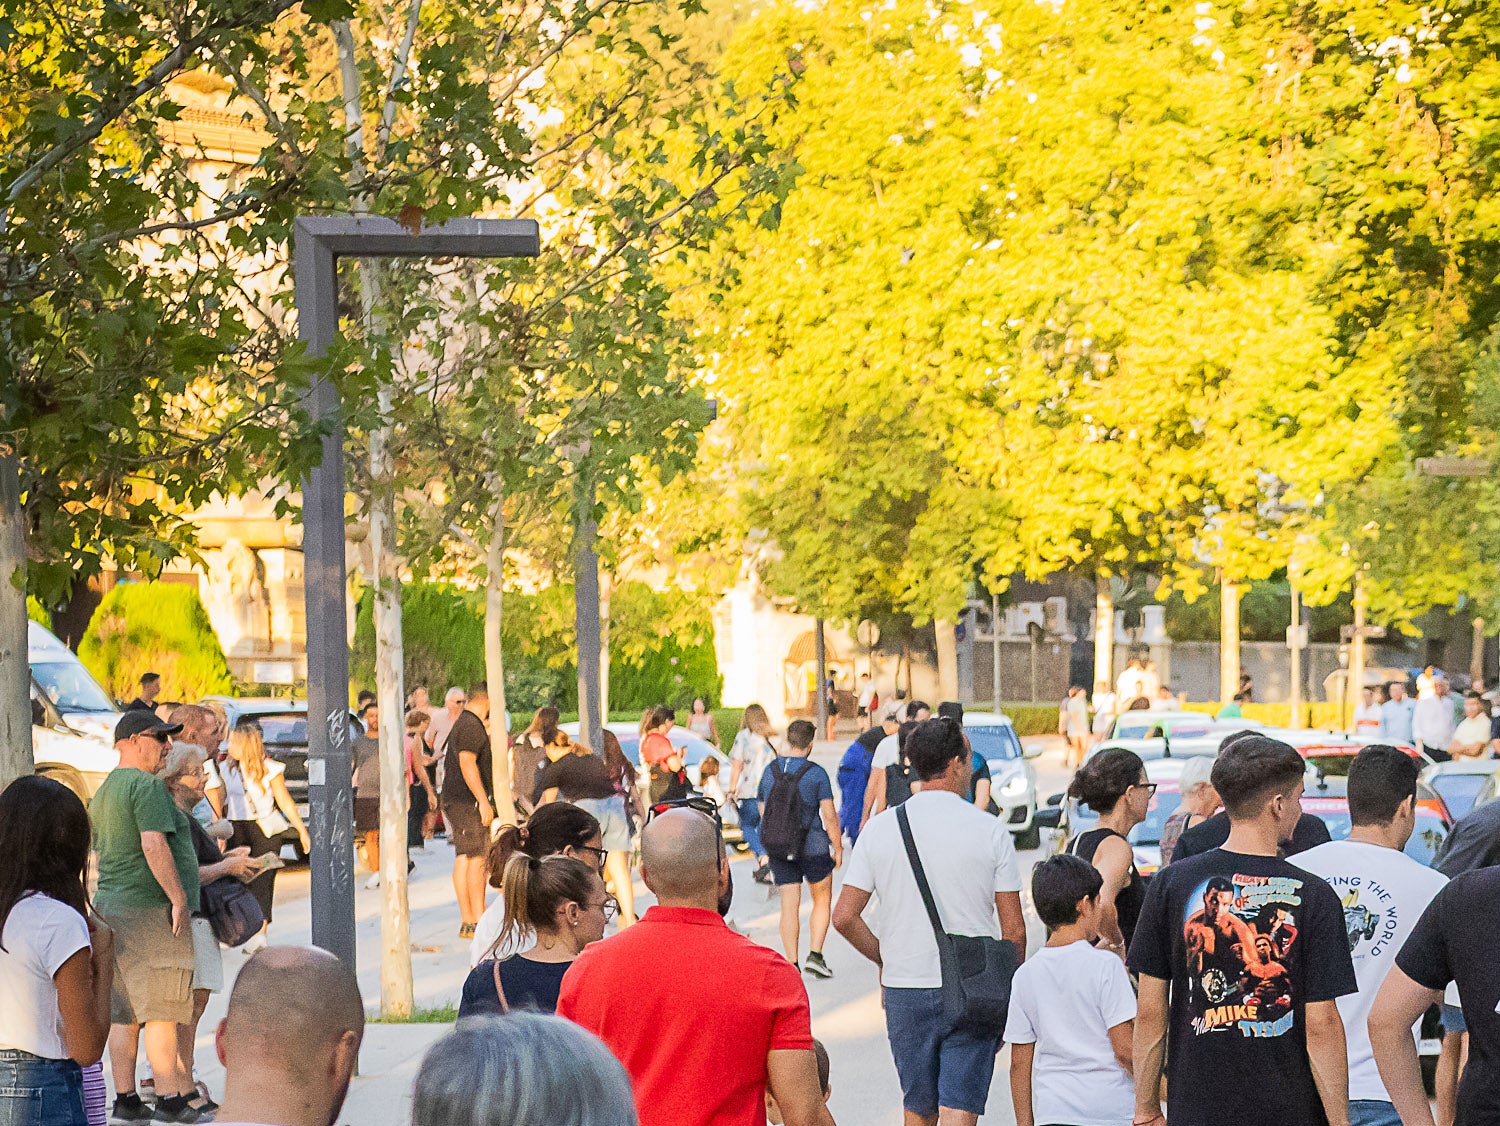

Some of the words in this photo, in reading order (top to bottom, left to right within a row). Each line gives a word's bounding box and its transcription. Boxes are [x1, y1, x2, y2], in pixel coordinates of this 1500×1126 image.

[1367, 880, 1393, 903] THE
[1371, 906, 1398, 956] WORLD
[1204, 1005, 1258, 1027] MIKE
